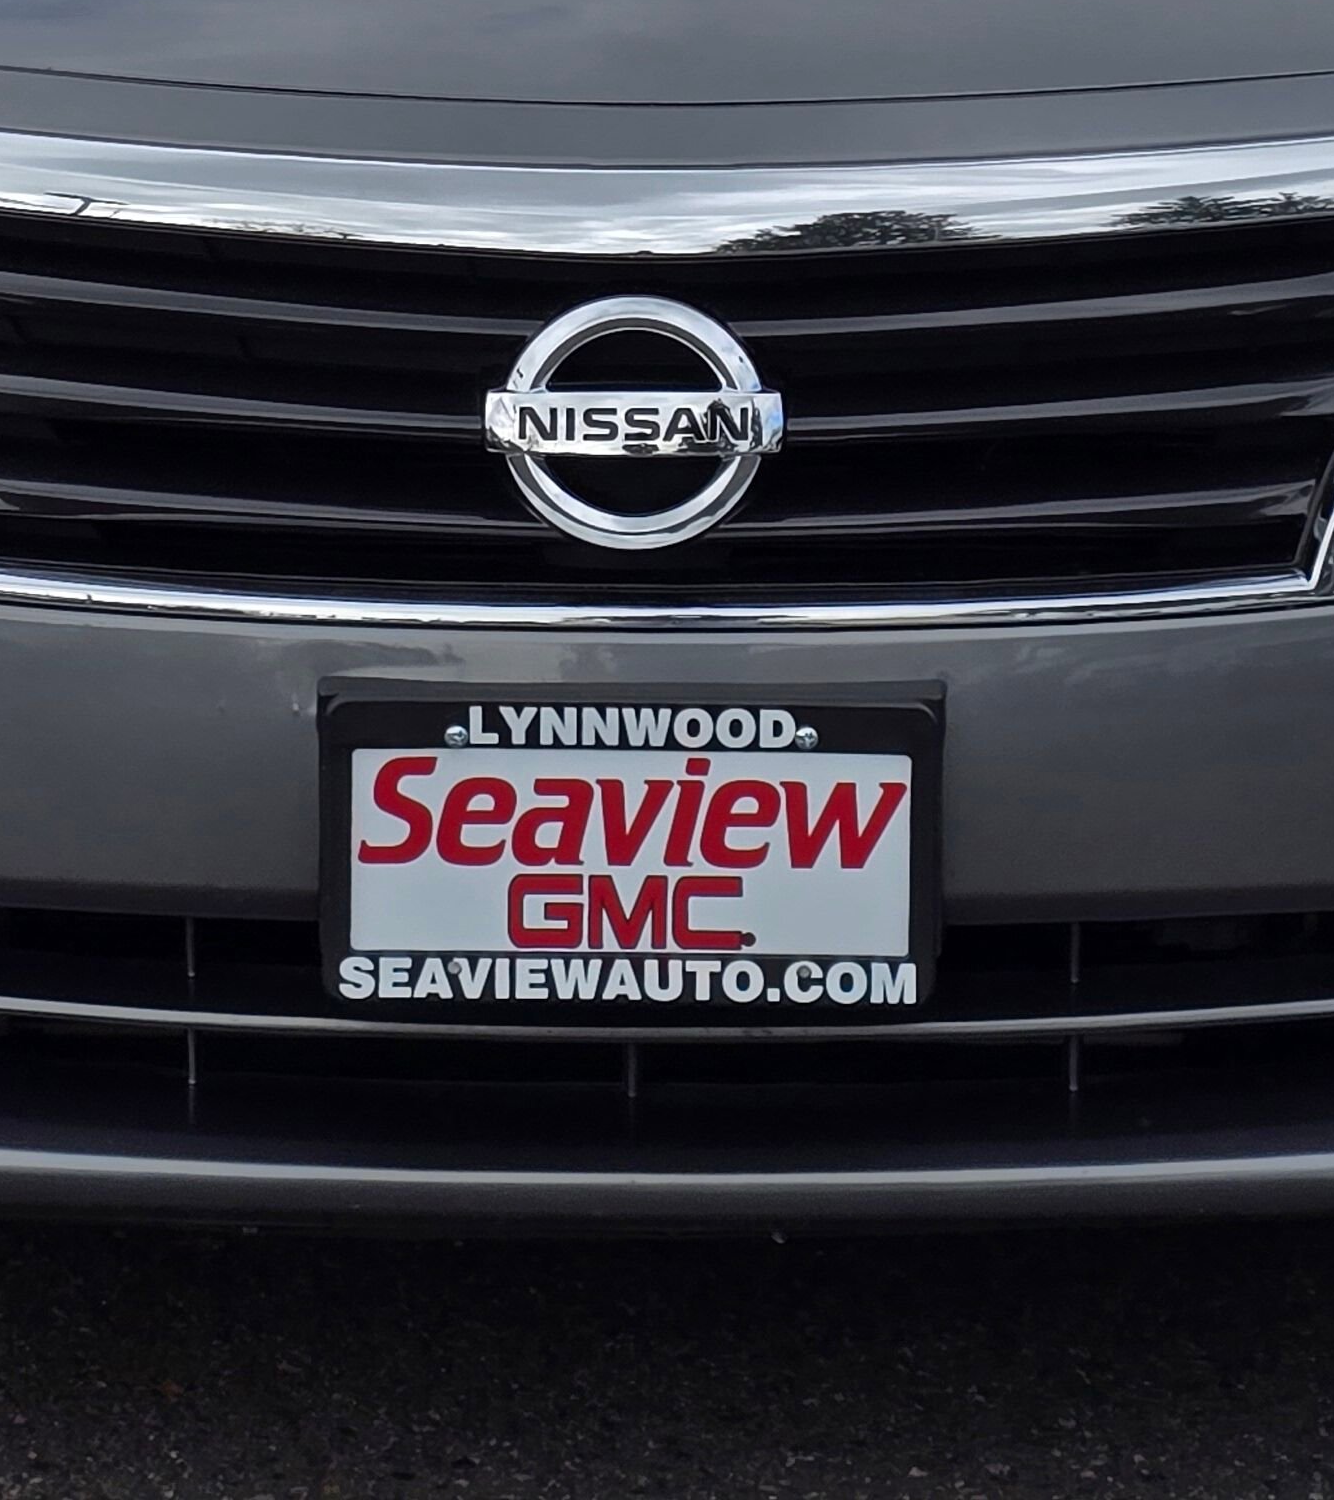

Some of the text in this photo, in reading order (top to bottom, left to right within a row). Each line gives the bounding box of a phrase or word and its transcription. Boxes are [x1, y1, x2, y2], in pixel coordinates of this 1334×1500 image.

[518, 406, 750, 443] NISSAN
[469, 706, 797, 748] LYNNWOOD
[357, 756, 908, 870] Seaview
[507, 873, 744, 951] GMC
[338, 957, 918, 1005] SEAVIEWAUTO.COM
